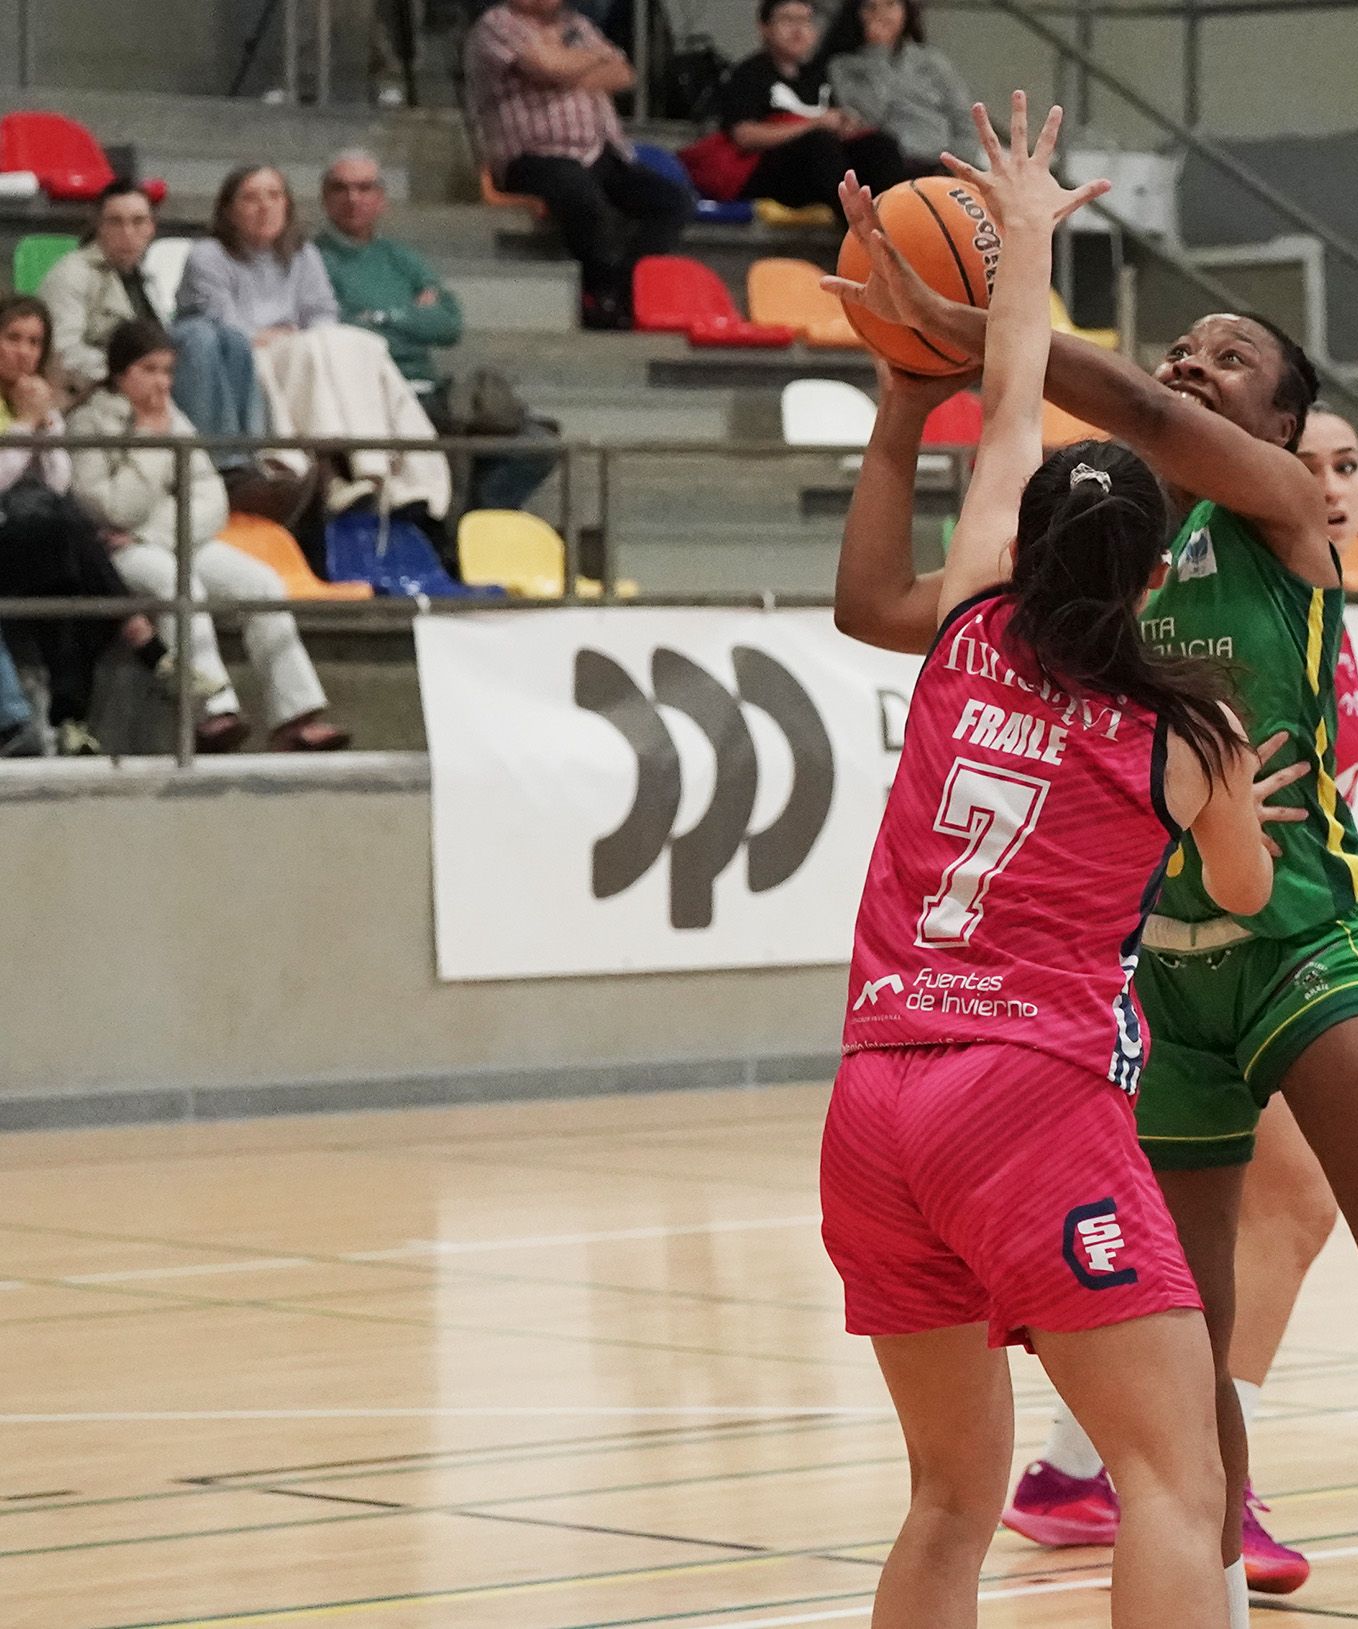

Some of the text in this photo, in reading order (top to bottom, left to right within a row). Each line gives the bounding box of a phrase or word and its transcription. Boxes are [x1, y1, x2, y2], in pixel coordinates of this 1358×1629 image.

[948, 188, 1001, 302] ilson
[952, 698, 1069, 766] FRAILE
[913, 756, 1052, 949] 7
[905, 989, 1039, 1018] de Invierno
[912, 967, 1004, 991] Fuentes
